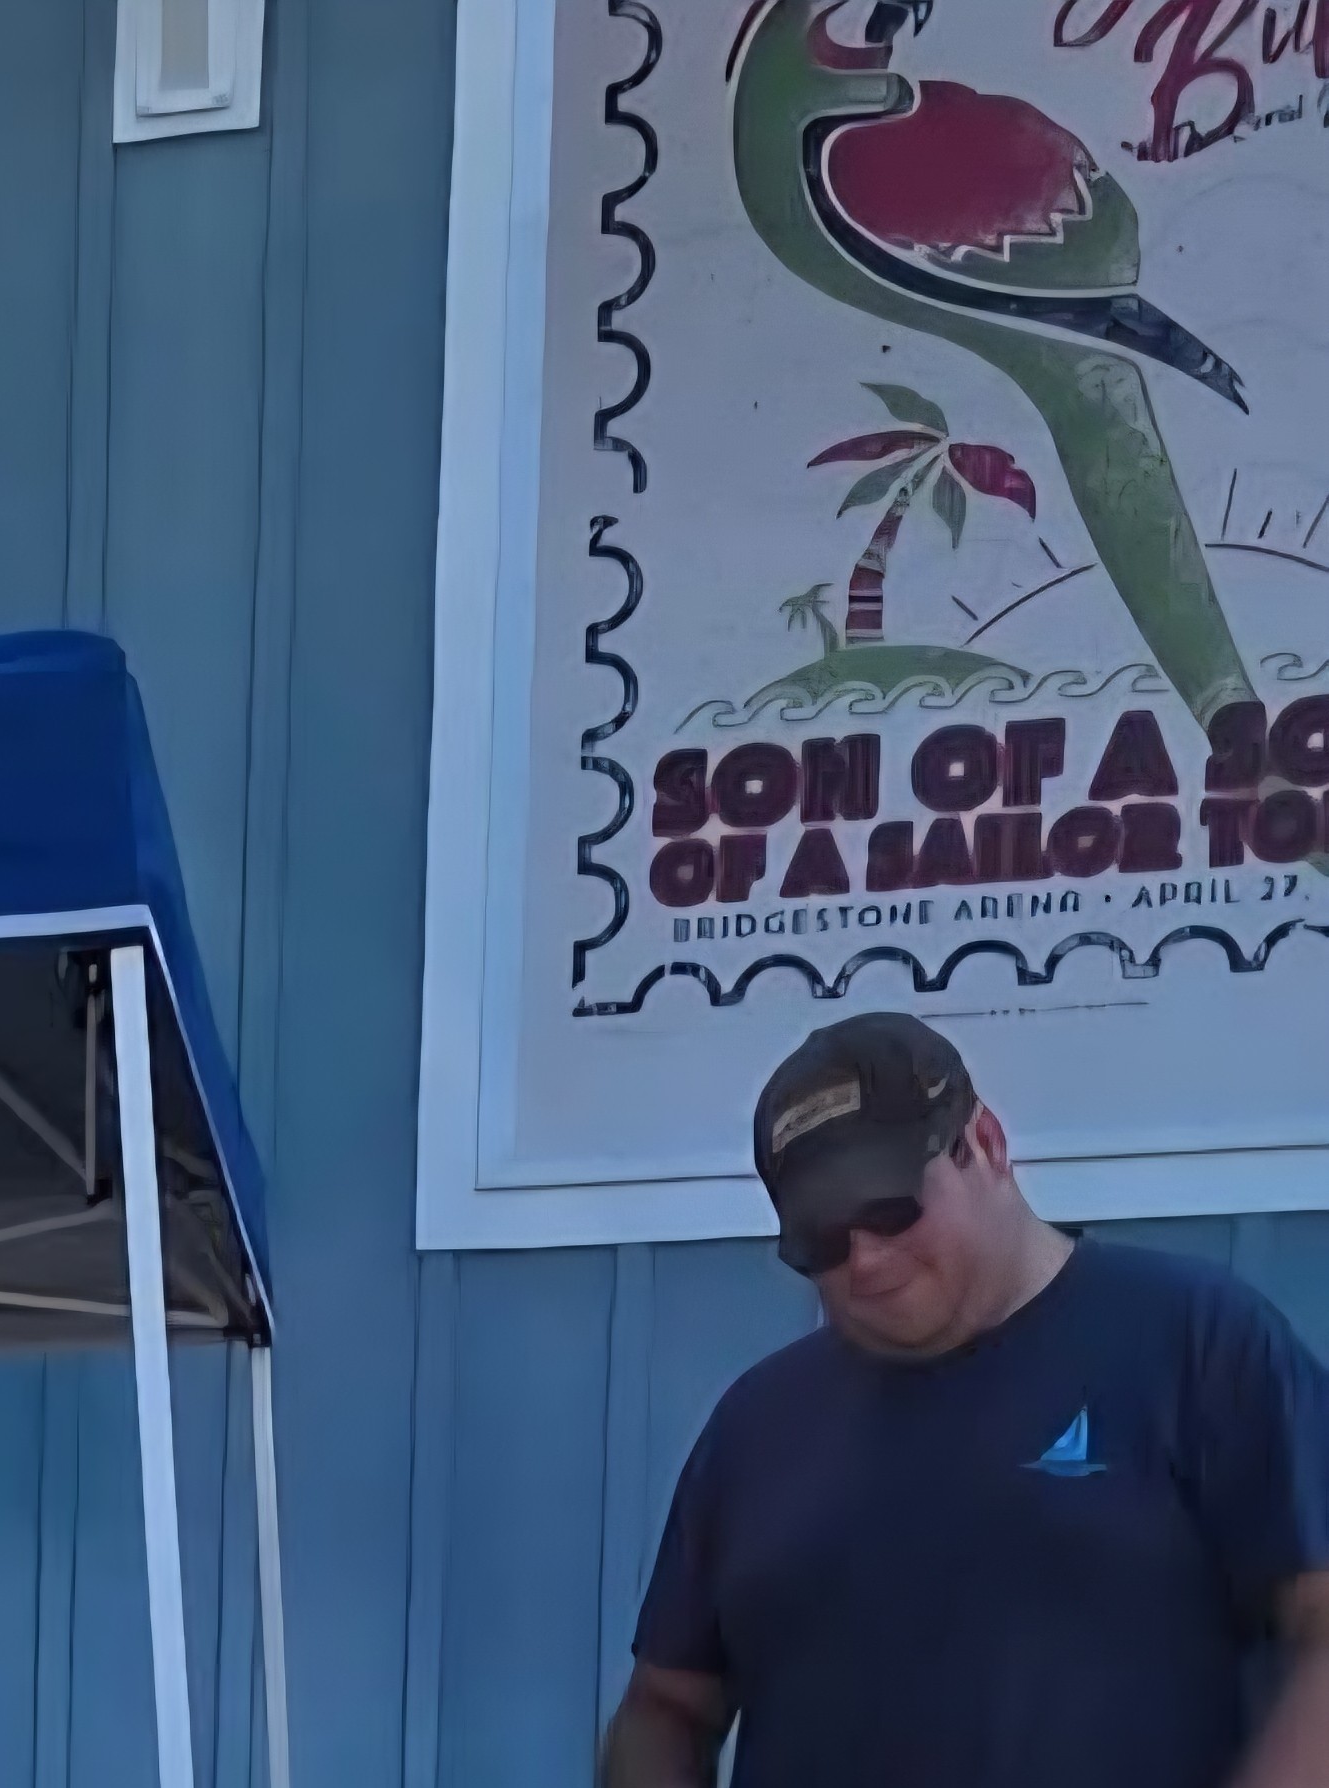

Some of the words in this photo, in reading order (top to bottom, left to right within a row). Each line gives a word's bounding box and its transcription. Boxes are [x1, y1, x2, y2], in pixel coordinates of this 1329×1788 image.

[652, 733, 881, 837] SON
[911, 717, 1067, 812] OF
[1088, 710, 1179, 800] A
[649, 833, 768, 908] OF
[779, 827, 851, 898] A
[866, 802, 1183, 892] SAILOR
[1199, 789, 1329, 869] TO
[673, 900, 933, 942] BRIDGESTONE
[954, 889, 1081, 922] ARENA
[1131, 876, 1240, 909] APRIL
